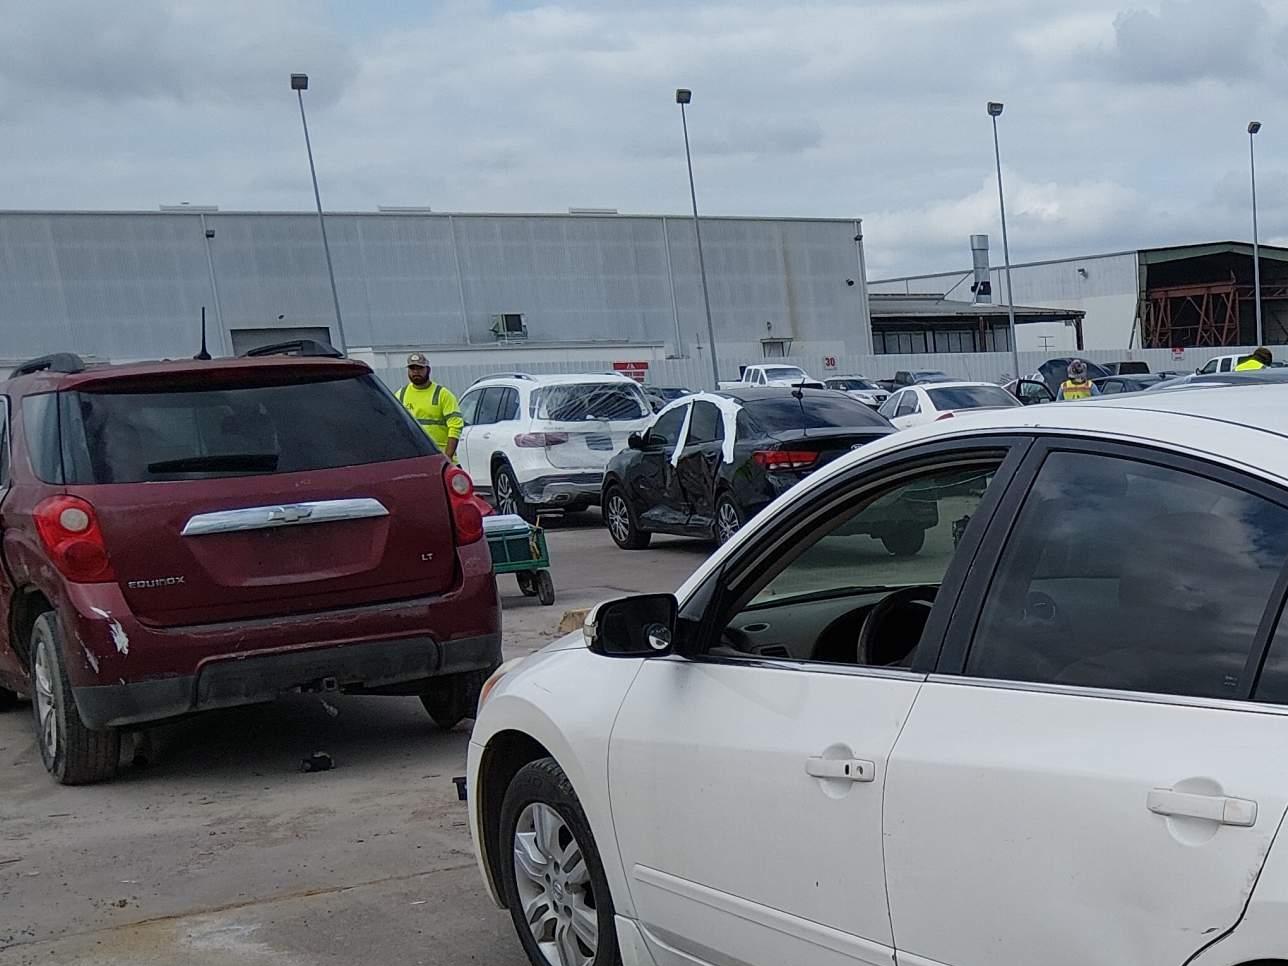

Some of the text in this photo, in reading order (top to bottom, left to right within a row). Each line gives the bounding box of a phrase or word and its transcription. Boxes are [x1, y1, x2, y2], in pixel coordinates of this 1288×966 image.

[825, 356, 836, 367] 30
[421, 553, 433, 561] LT
[127, 576, 185, 589] EQUINOX
